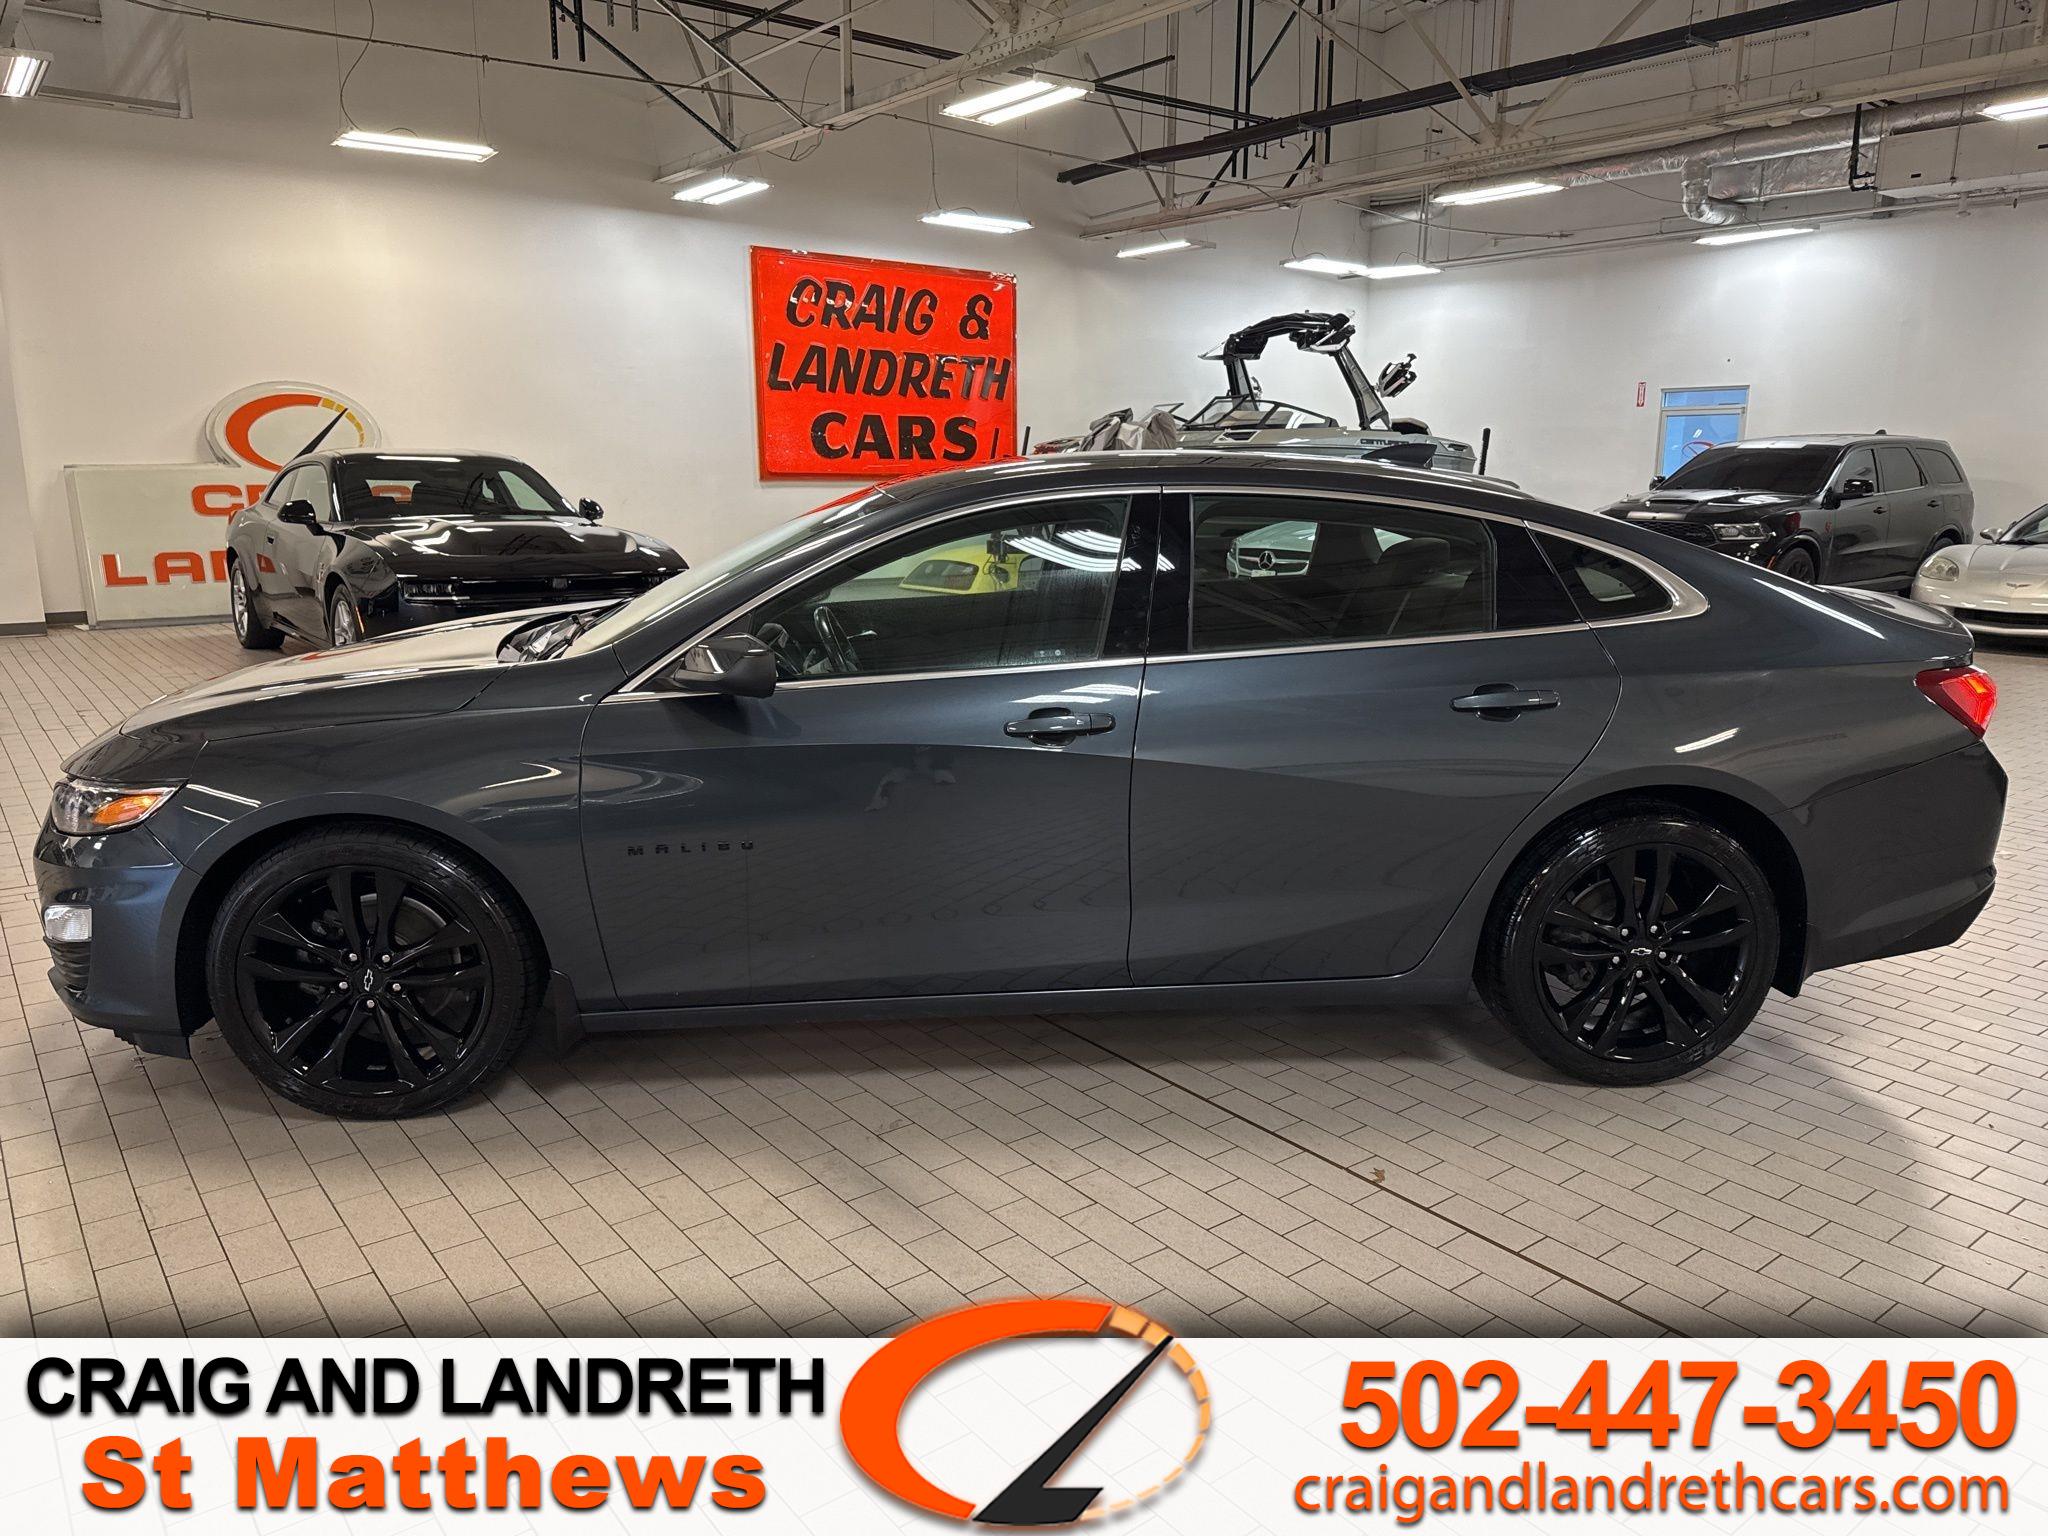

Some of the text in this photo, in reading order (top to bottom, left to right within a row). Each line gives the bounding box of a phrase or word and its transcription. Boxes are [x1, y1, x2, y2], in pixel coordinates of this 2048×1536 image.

[786, 278, 993, 340] CRAIG &
[768, 342, 1011, 400] LANDRETH
[811, 412, 977, 460] CARS
[627, 841, 754, 856] MALIBU
